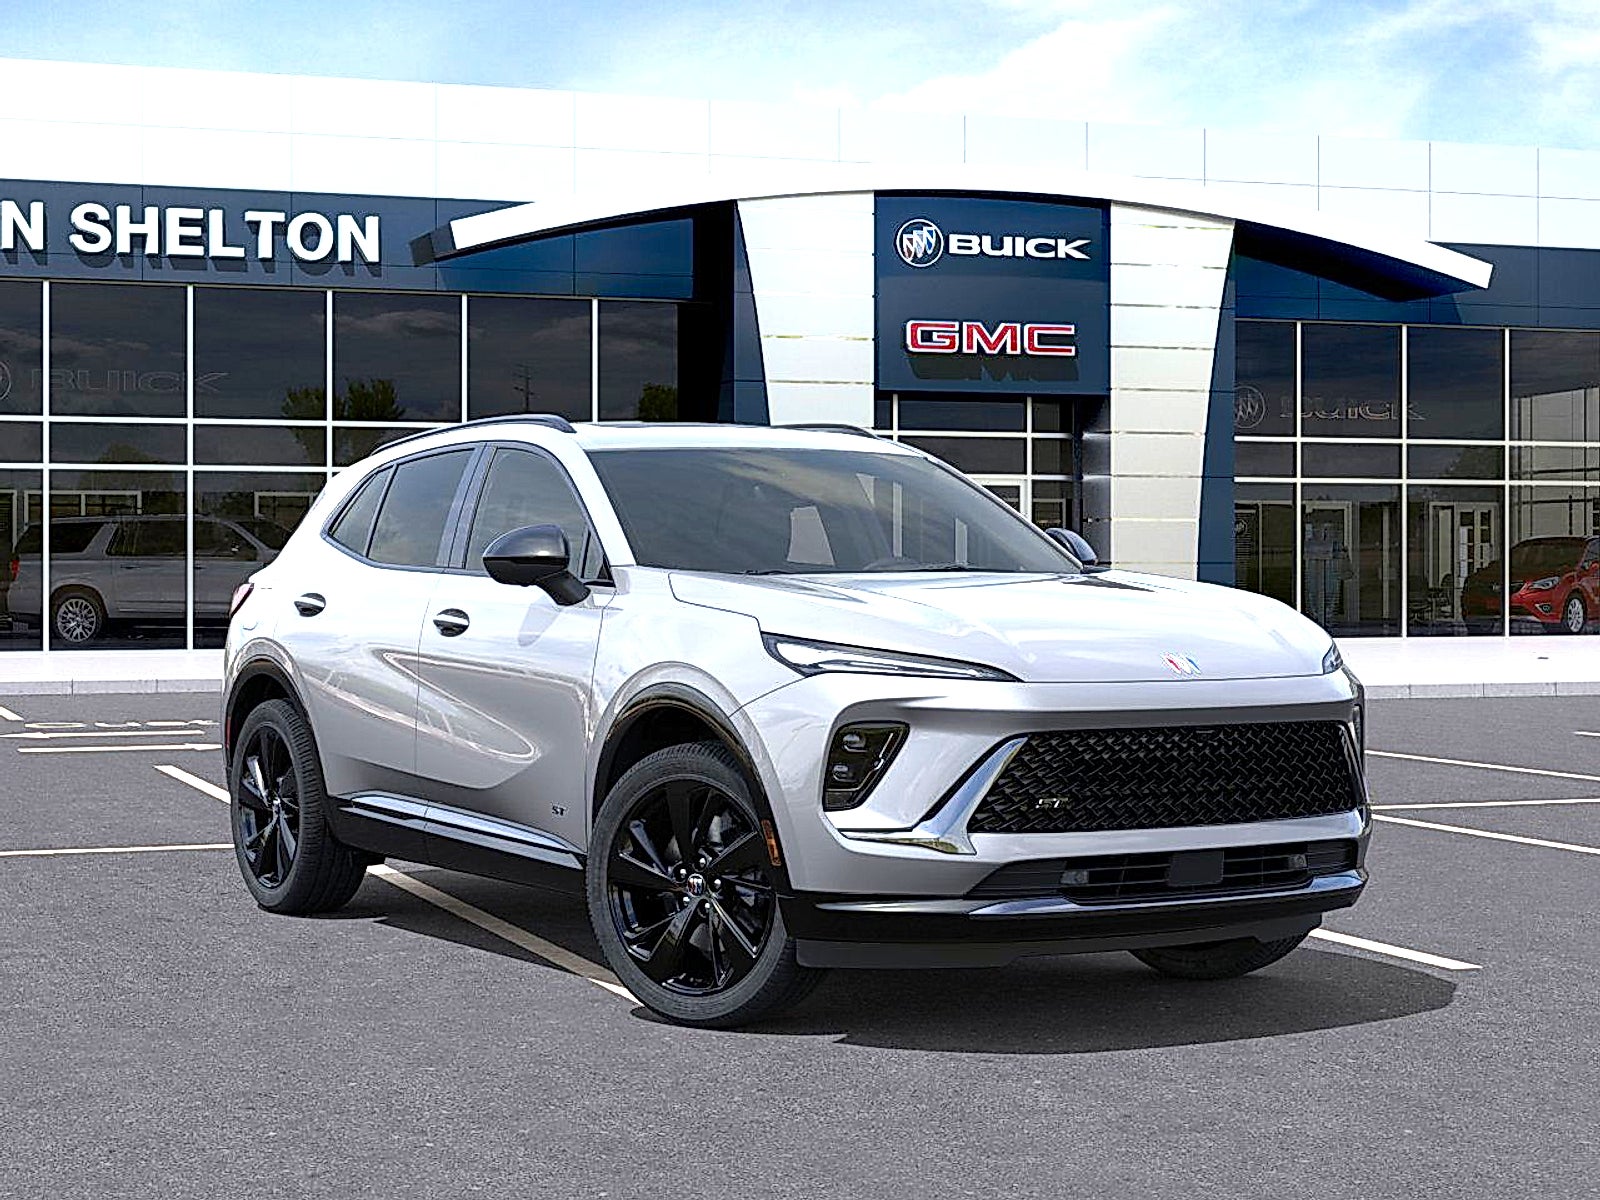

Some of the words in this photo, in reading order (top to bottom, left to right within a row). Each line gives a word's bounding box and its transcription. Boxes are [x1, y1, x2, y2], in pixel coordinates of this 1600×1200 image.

[1, 200, 44, 250] N
[69, 202, 381, 263] SHELTON
[948, 233, 1092, 260] BUICK
[906, 319, 1076, 357] GMC
